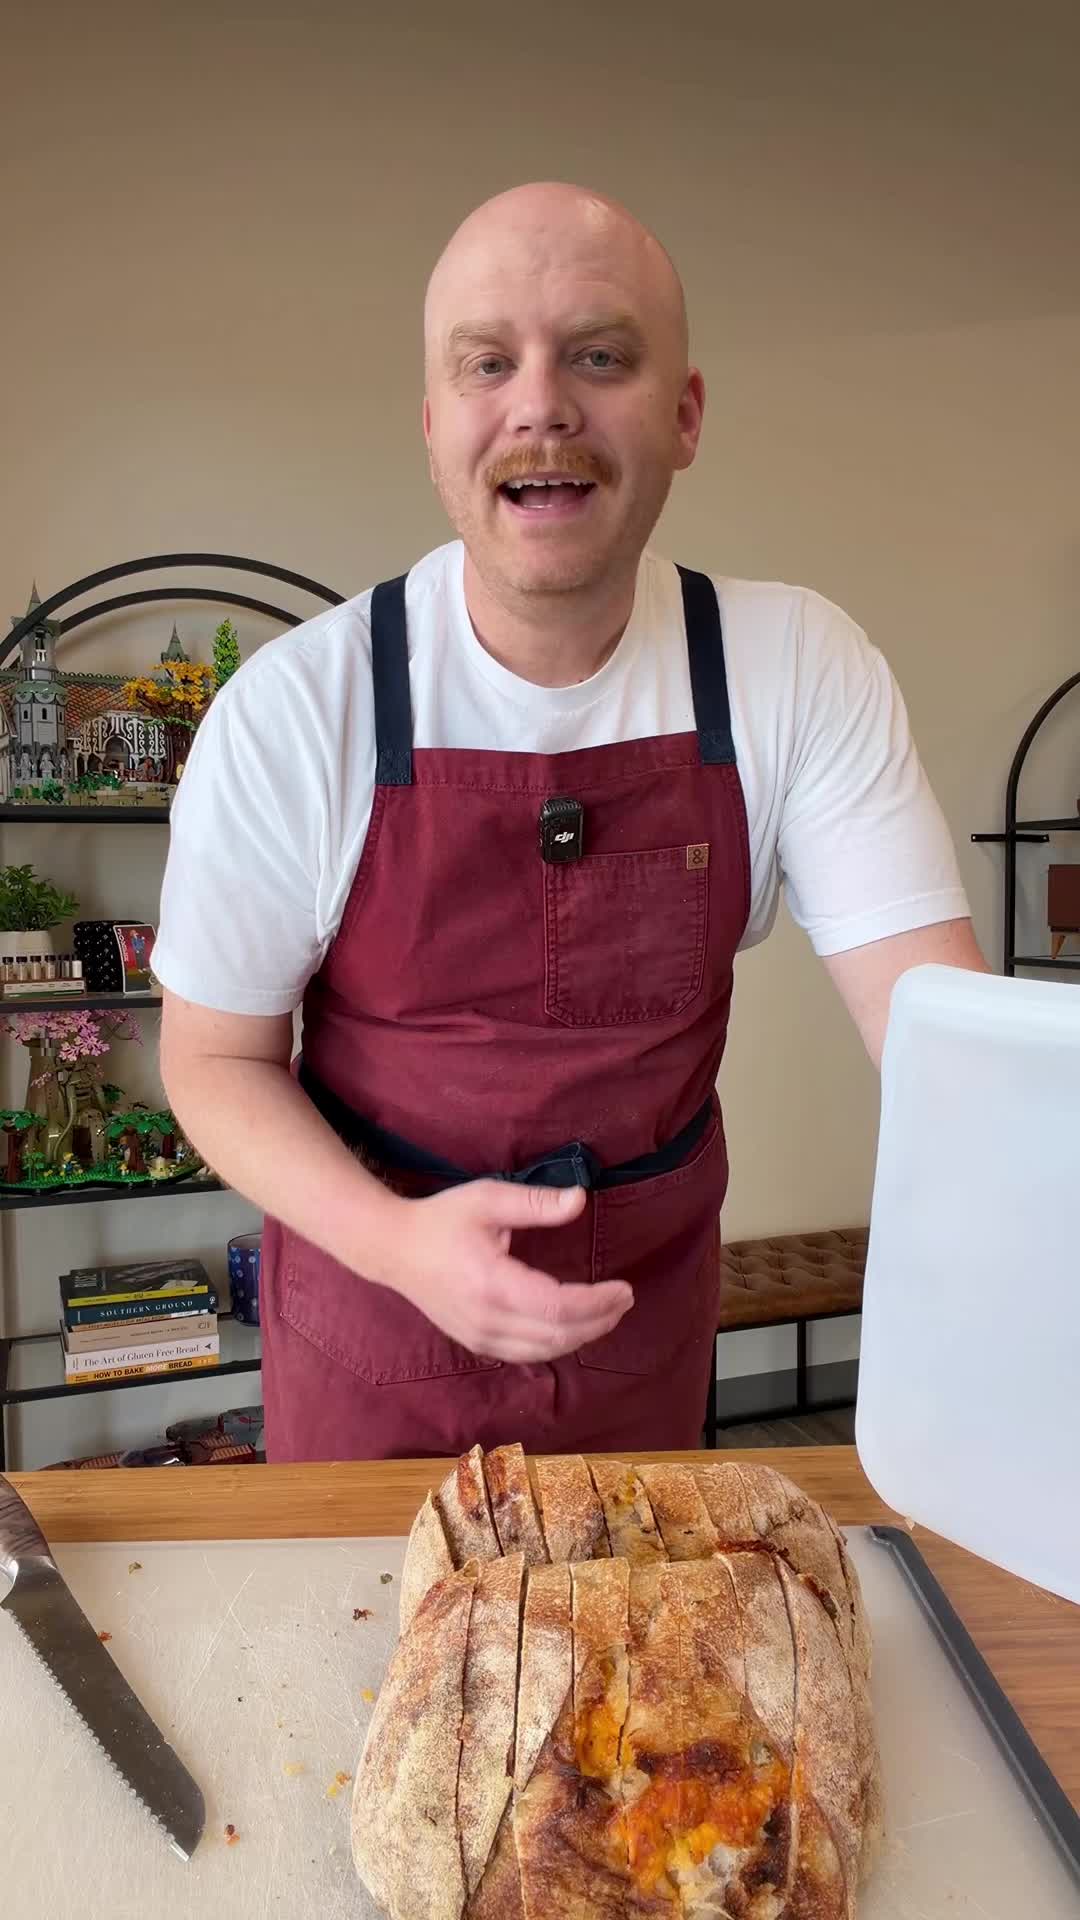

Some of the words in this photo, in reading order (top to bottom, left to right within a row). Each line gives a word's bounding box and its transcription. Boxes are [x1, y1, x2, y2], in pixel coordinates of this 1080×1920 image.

[101, 1305, 150, 1317] SOUTHERN
[155, 1300, 193, 1312] GROUND
[83, 1356, 98, 1367] The
[100, 1354, 116, 1366] Art
[117, 1352, 126, 1363] of
[127, 1349, 154, 1361] Gluten
[156, 1347, 174, 1358] Free
[176, 1344, 199, 1355] Bread
[94, 1371, 111, 1380] HOW
[112, 1368, 123, 1377] TO
[124, 1366, 144, 1376] BAKE
[168, 1360, 193, 1370] BREAD
